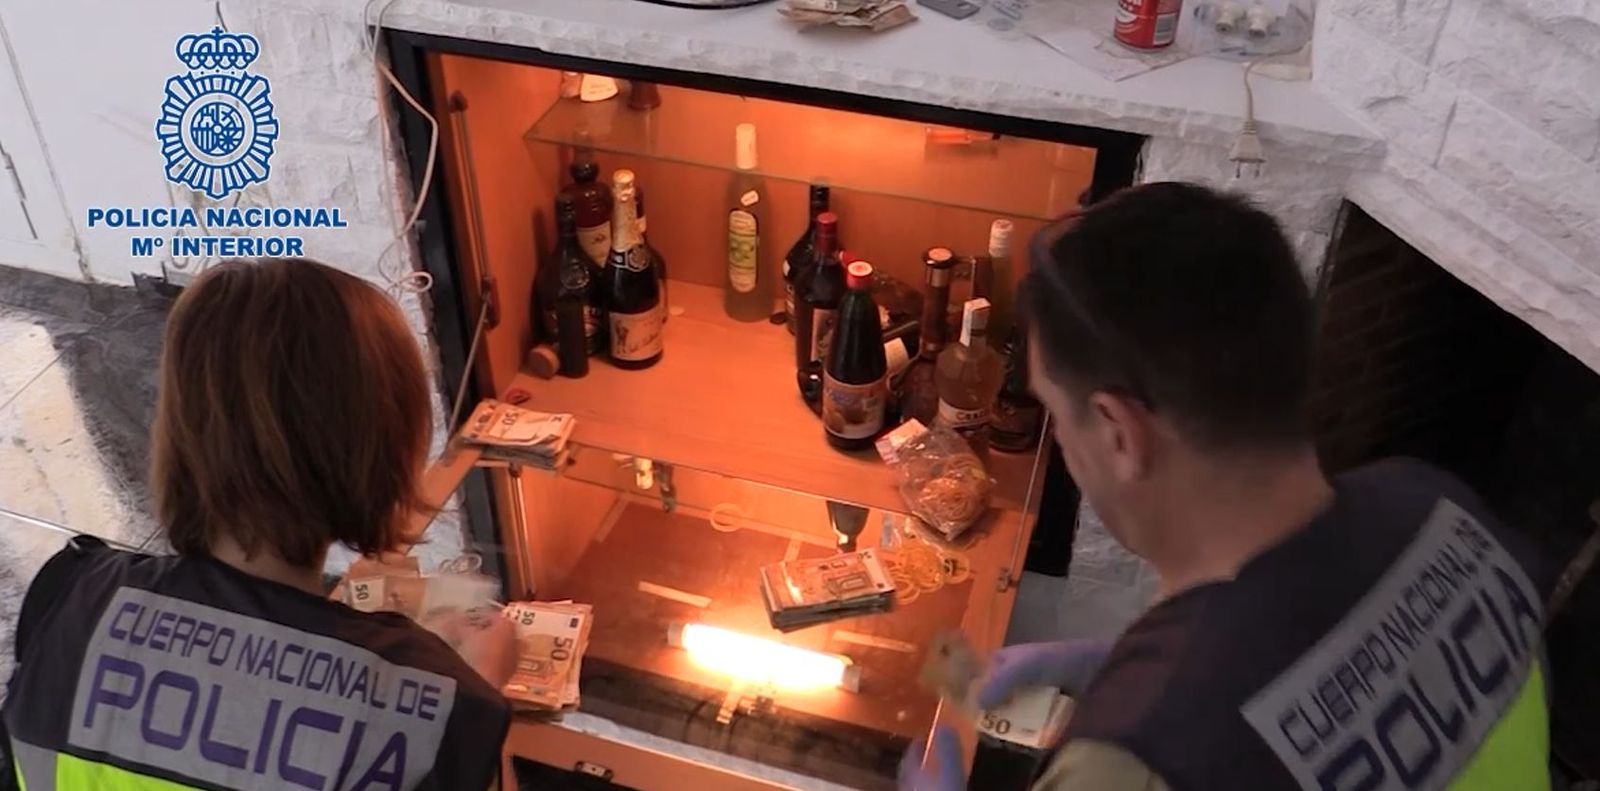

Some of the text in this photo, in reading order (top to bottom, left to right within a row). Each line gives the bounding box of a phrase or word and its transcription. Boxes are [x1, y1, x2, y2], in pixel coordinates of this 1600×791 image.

[354, 583, 369, 601] 50
[521, 610, 536, 626] 50
[109, 601, 442, 722] CUERPO NACIONAL DE
[550, 636, 575, 662] 50
[1279, 633, 1395, 756] CUERPO
[1379, 541, 1479, 662] NACIONAL
[1316, 565, 1541, 791] POLICIA
[83, 654, 410, 791] POLICIA
[981, 712, 1011, 735] 50
